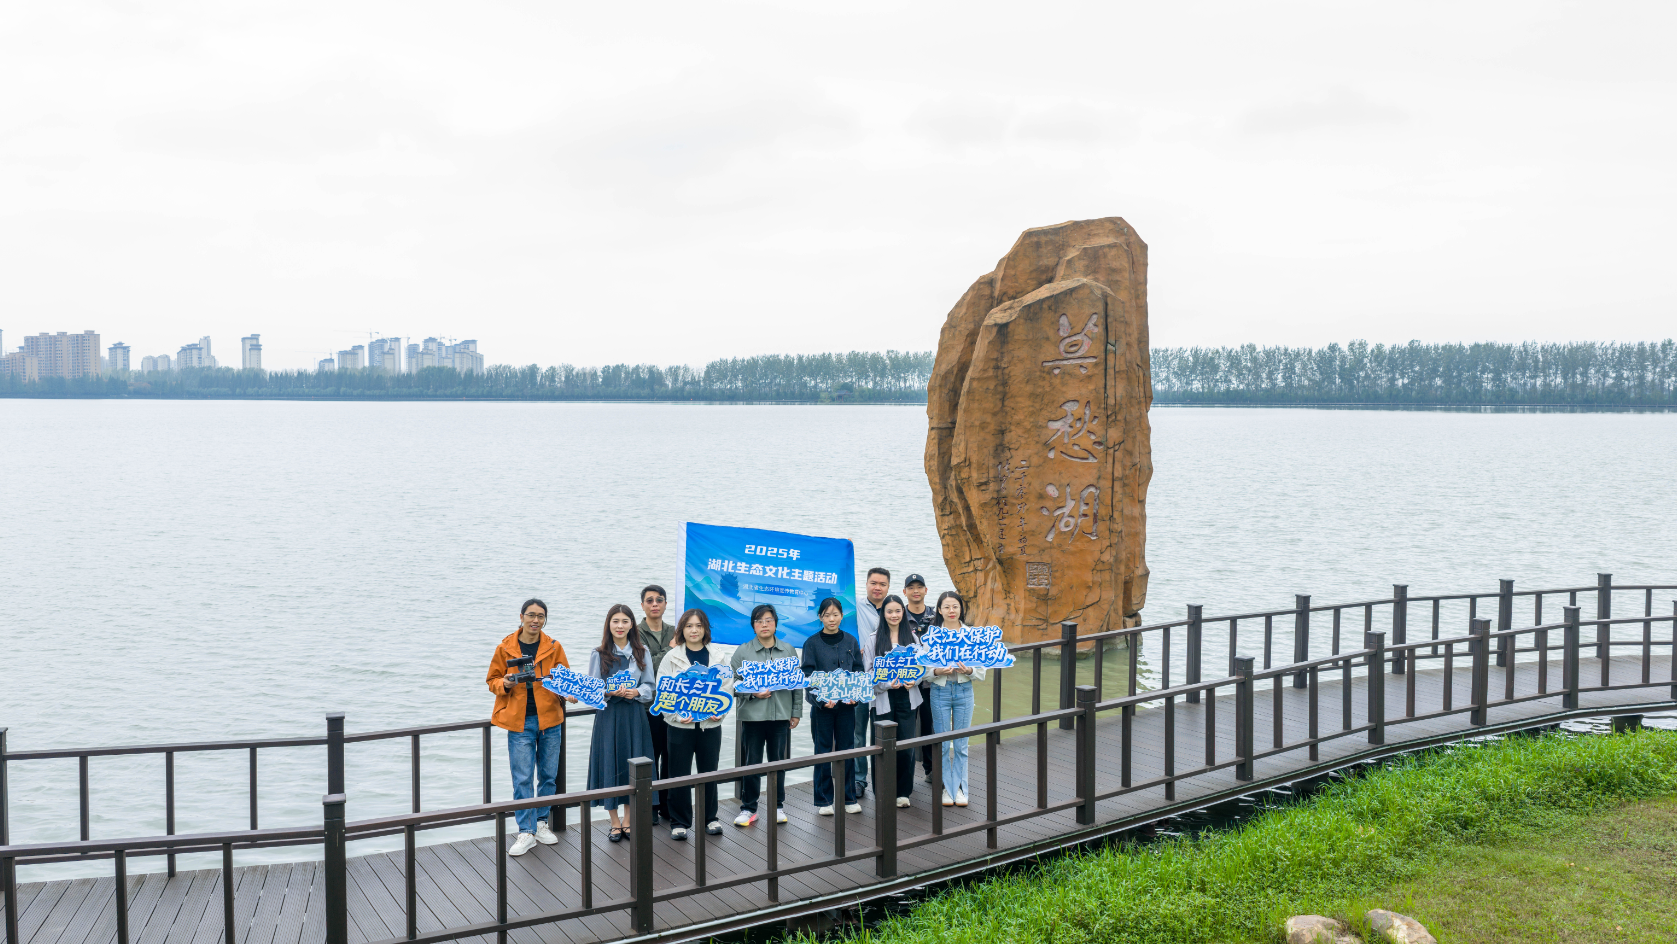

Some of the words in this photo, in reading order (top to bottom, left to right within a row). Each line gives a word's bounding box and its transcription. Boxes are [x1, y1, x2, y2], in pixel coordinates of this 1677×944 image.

[744, 544, 801, 561] 2025年
[707, 558, 838, 585] 湖北生态文化主题活动
[923, 626, 1001, 647] 长江大保护
[875, 656, 914, 668] 和长江
[928, 642, 1005, 666] 我们在行动
[739, 658, 798, 676] 长江大保护
[874, 667, 918, 683] 楚个朋友
[551, 664, 604, 691] 长江大保护
[659, 678, 718, 694] 和长江
[743, 669, 803, 691] 我们在行动
[811, 672, 873, 688] 绿水青山就
[551, 678, 604, 704] 我们在行动
[818, 686, 873, 701] 是金山银山
[653, 691, 721, 715] 楚个朋友
